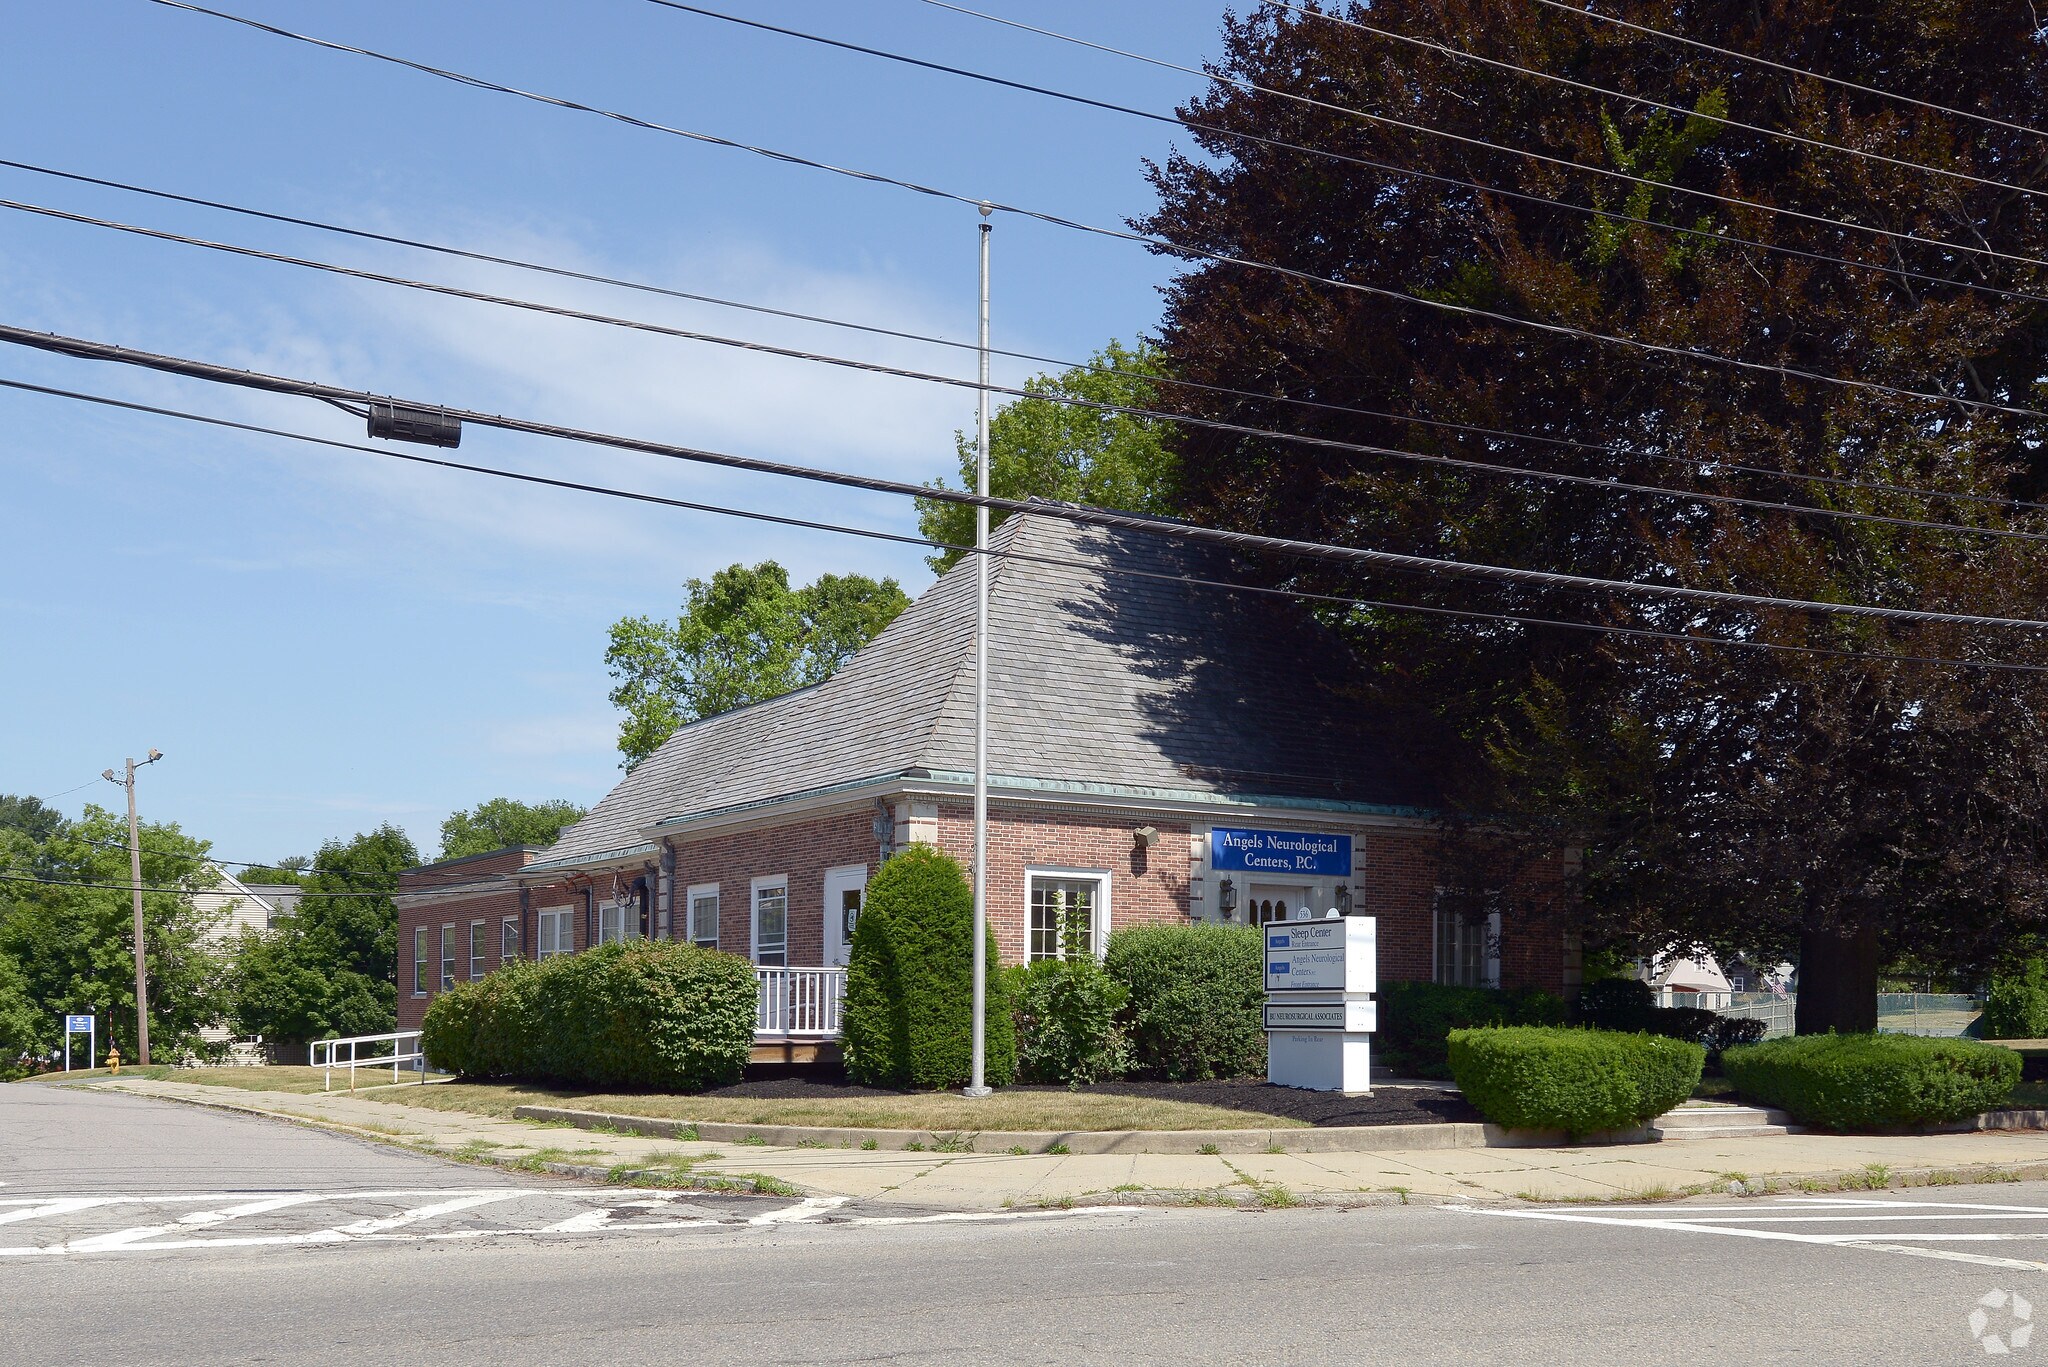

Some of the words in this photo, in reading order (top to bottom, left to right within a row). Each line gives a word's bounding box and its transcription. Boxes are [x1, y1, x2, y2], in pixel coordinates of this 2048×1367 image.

[1223, 832, 1263, 850] Angels
[1266, 835, 1338, 854] Neurological
[1244, 852, 1292, 871] Centers,
[1295, 855, 1317, 870] P.C.
[1290, 928, 1310, 940] Sleep
[1310, 926, 1332, 938] Center
[1292, 955, 1310, 965] Angels
[1311, 953, 1344, 964] Neurological
[1291, 967, 1311, 976] Centers
[1276, 1012, 1314, 1020] NEUROSURGICAL
[1314, 1012, 1342, 1020] ASSOCIATES
